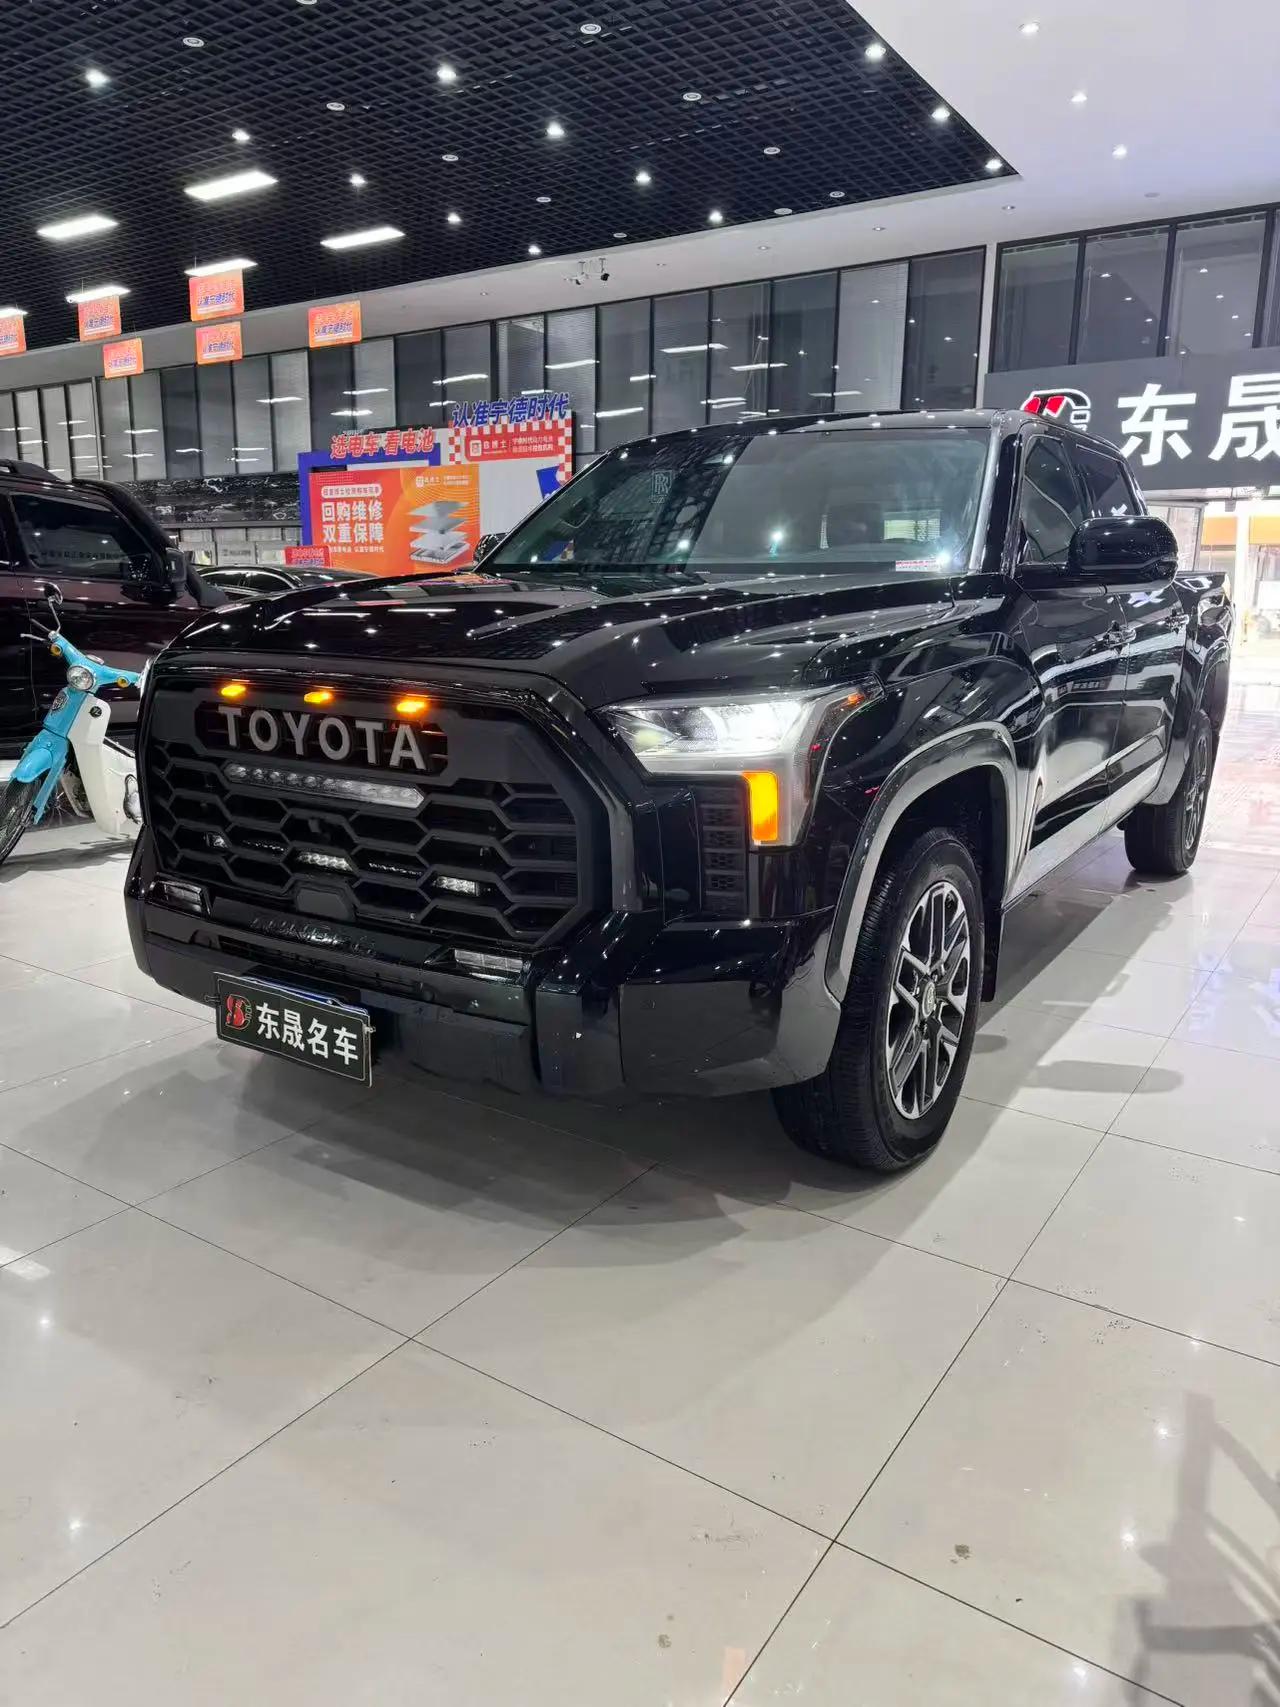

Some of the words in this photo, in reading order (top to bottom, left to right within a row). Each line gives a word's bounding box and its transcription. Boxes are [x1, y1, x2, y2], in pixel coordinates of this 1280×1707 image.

[452, 392, 569, 427] 认准宁德时代
[1117, 372, 1280, 466] 东晟
[330, 431, 380, 459] 选电车
[383, 426, 434, 456] 看电池
[321, 499, 384, 522] 回购维修
[322, 522, 385, 543] 双重保障
[218, 705, 427, 770] TOYOTA
[256, 1002, 359, 1066] 东晟名车
